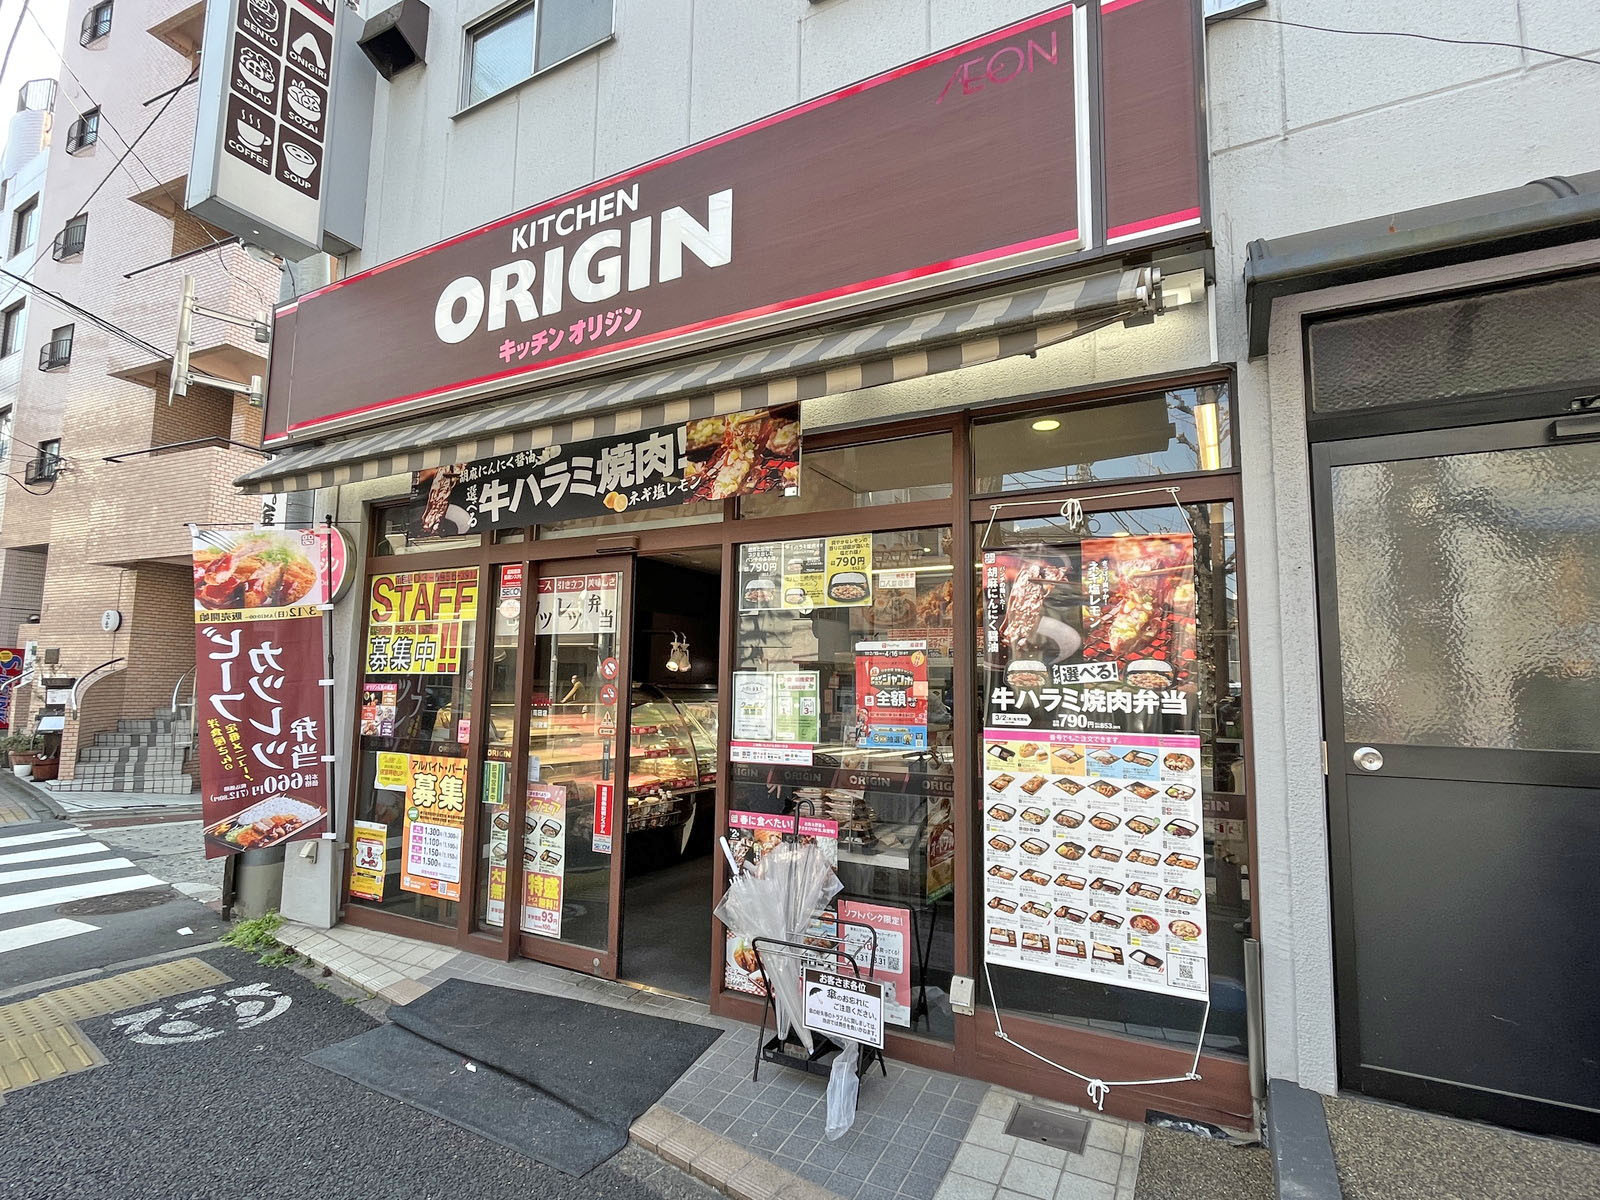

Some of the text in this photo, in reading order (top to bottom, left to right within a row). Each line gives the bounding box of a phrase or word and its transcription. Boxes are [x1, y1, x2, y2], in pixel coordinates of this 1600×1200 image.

[243, 18, 278, 47] BENTO
[289, 51, 327, 80] ONIGIRI
[236, 78, 272, 106] SALAD
[288, 111, 319, 134] SOZAI
[228, 139, 269, 167] COFFEE
[283, 170, 311, 189] SOUP
[511, 183, 639, 253] KITCHEN
[434, 188, 733, 344] ORIGIN
[460, 450, 537, 483] 胡麻にんにく醤油
[479, 425, 688, 523] 牛ハラミ焼肉!
[628, 475, 701, 506] ネギ塩レモン
[466, 484, 478, 528] 選べる
[749, 562, 777, 573] 790円
[836, 556, 865, 567] 790円
[371, 577, 478, 623] STAFF
[502, 587, 521, 596] SECO
[1087, 561, 1101, 629] ネギ塩レモン
[987, 567, 999, 653] 胡麻にんにく醤油
[1062, 663, 1118, 682] 選べる!
[876, 690, 907, 707] 全額
[991, 687, 1188, 715] 牛ハラミ焼肉弁当
[1057, 714, 1095, 729] 790円
[412, 760, 467, 776] アルバイト・パート
[784, 770, 821, 782] ORIGIN
[412, 771, 464, 812] 募集
[849, 775, 890, 787] ORIGIN
[923, 780, 954, 791] ORIG
[740, 814, 794, 829] 春に食べたい!
[845, 909, 903, 926] ソフトバンク限定!
[819, 974, 867, 993] お客さま各位
[827, 988, 870, 1008] 傘のお忘れに
[833, 1003, 877, 1020] ご注意ください。
